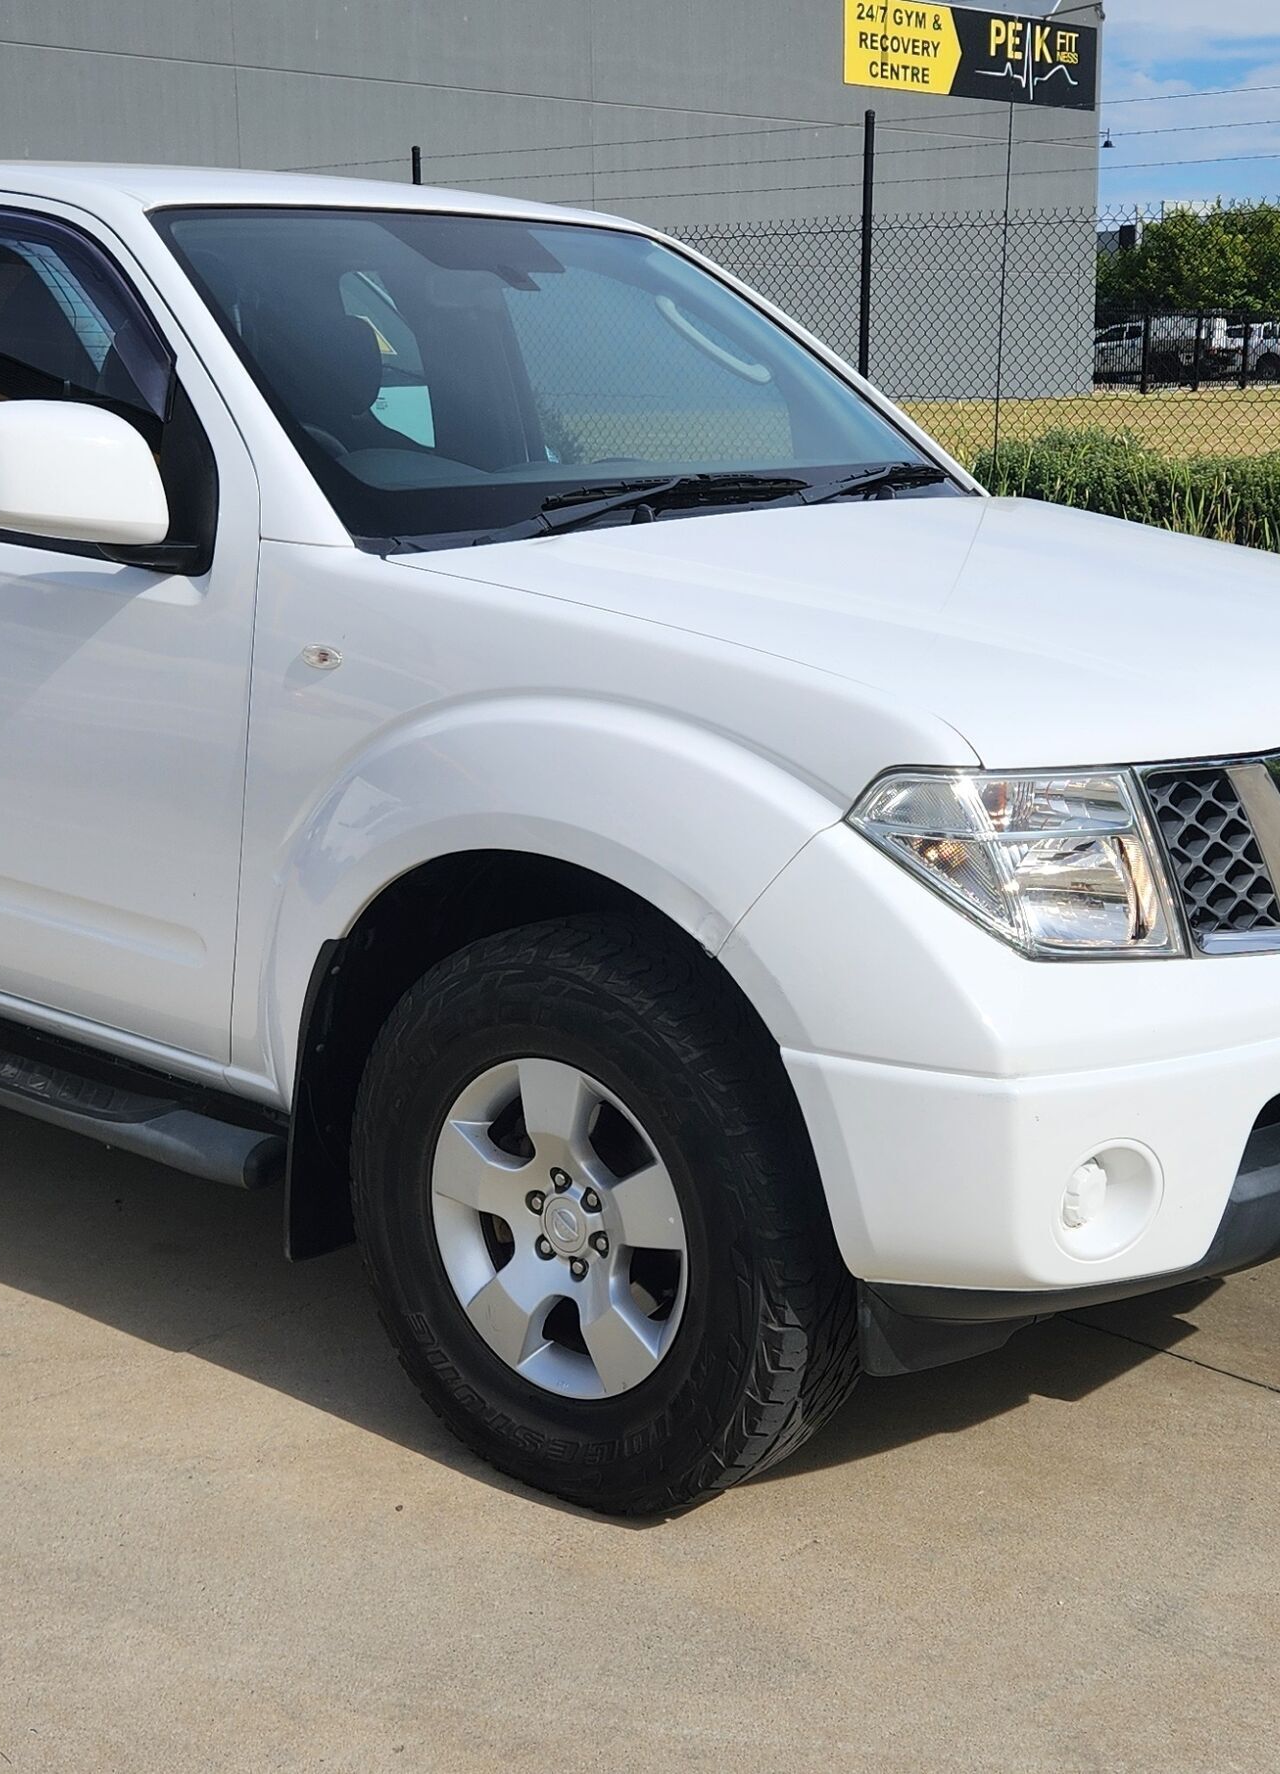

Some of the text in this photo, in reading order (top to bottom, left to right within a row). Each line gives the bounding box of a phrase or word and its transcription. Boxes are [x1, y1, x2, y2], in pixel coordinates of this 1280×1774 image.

[856, 3, 943, 31] 24/7 GYM &
[858, 33, 941, 58] RECOVERY
[1056, 30, 1080, 53] FIT
[1056, 51, 1079, 65] NESS
[869, 61, 930, 84] CENTRE
